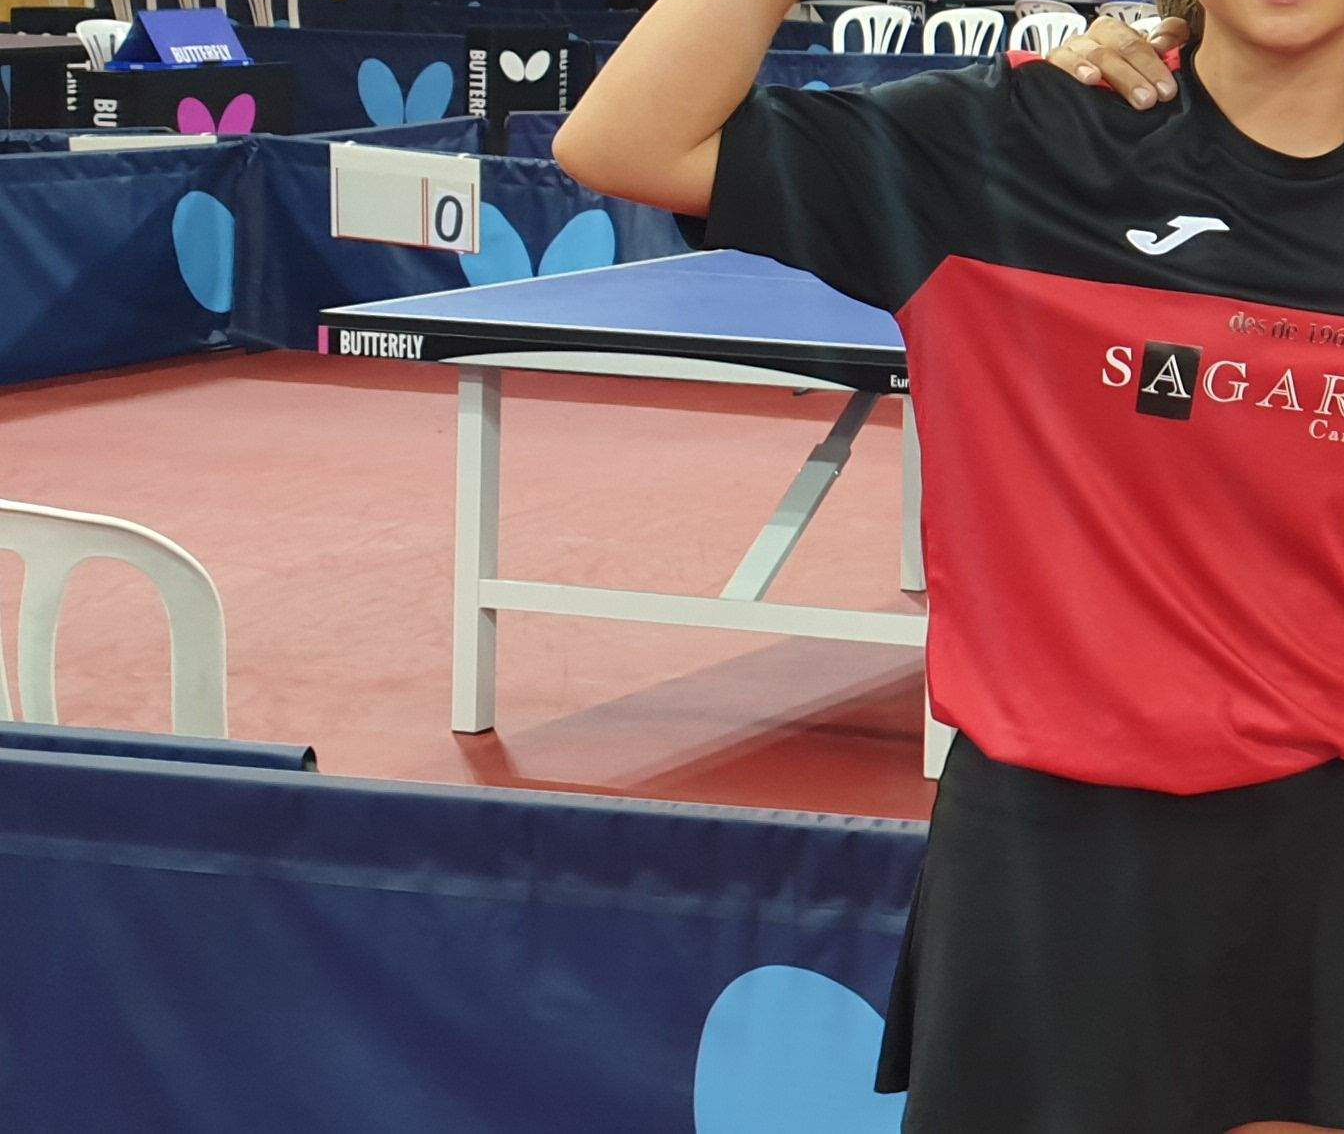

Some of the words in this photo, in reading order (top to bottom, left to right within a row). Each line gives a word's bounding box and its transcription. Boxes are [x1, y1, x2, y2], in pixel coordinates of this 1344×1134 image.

[170, 44, 232, 64] BUTTERFLY
[434, 194, 464, 243] 0
[339, 329, 424, 360] BUTTERFLY
